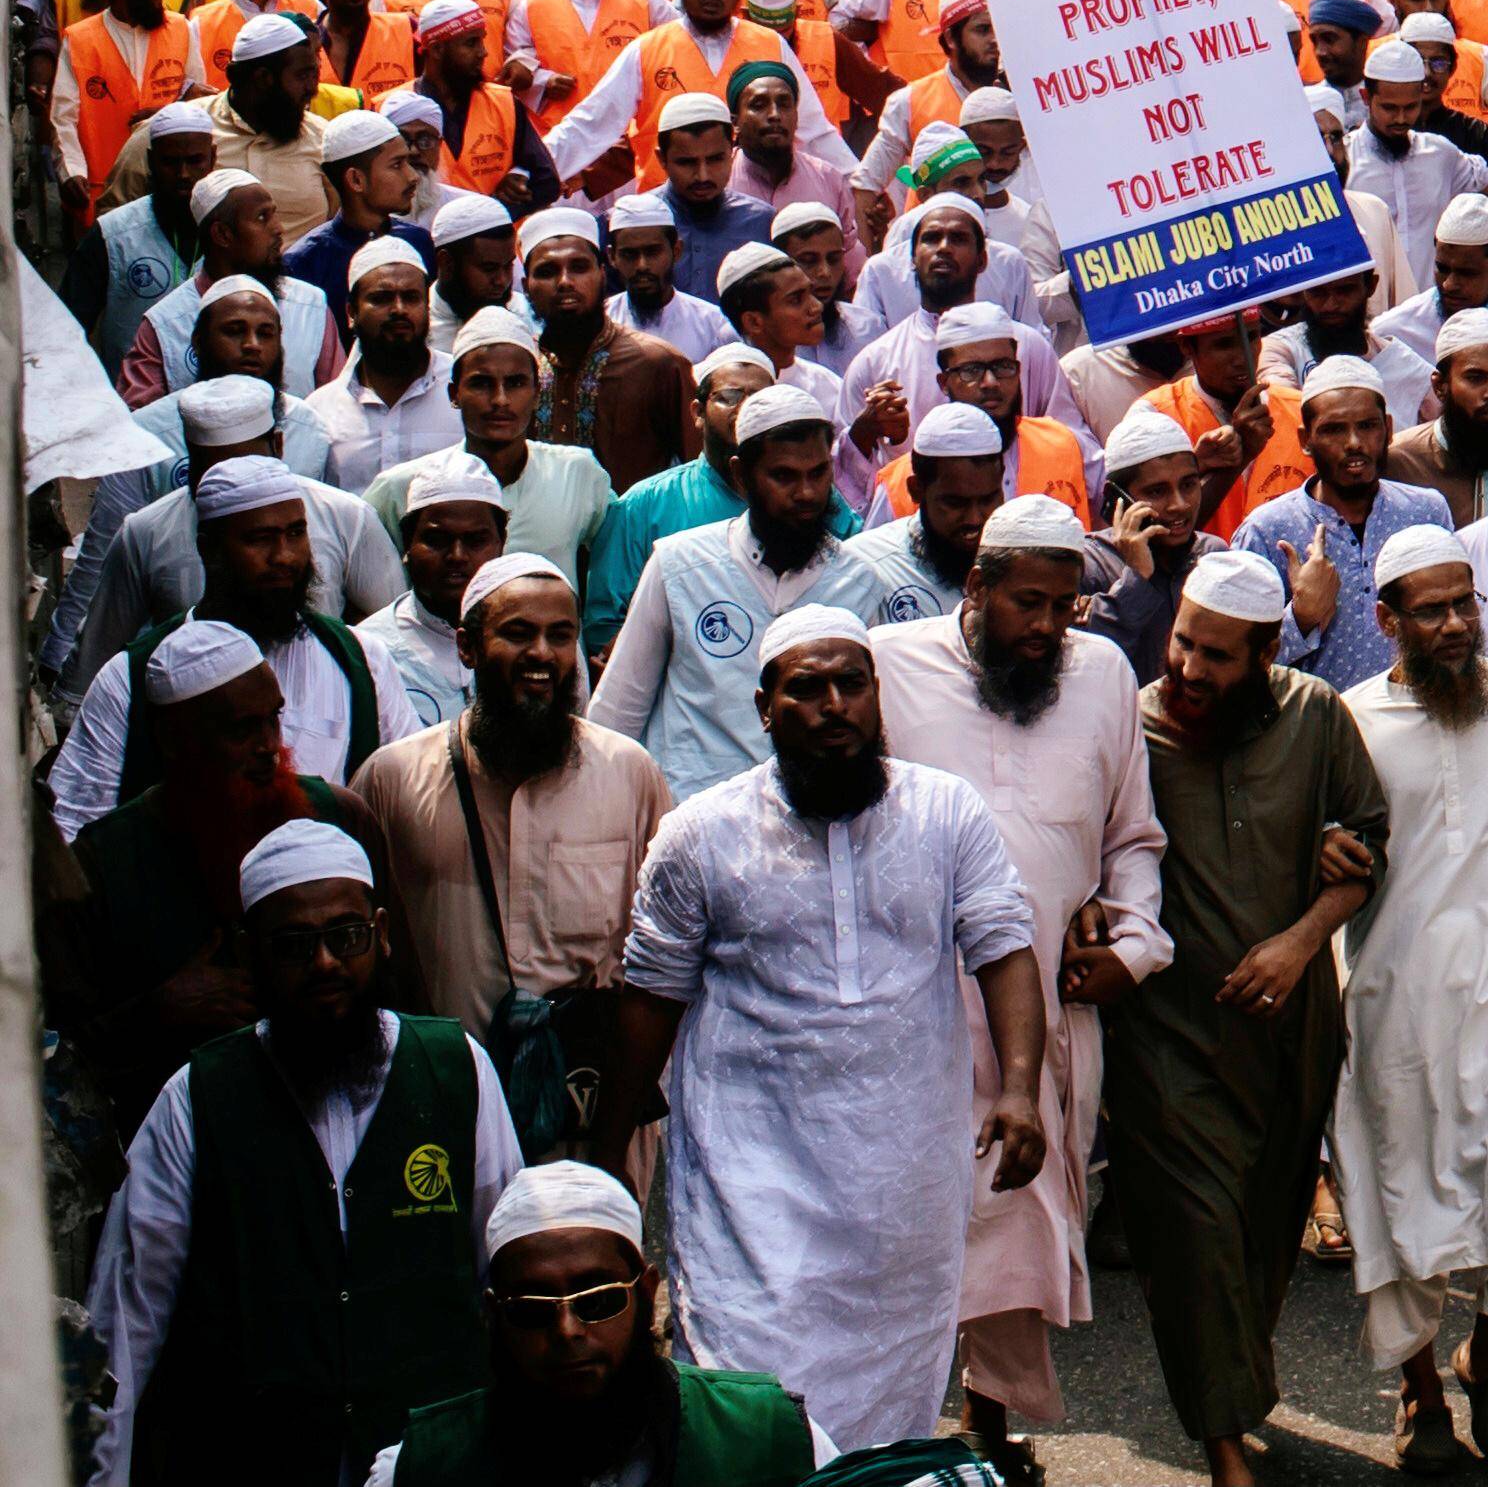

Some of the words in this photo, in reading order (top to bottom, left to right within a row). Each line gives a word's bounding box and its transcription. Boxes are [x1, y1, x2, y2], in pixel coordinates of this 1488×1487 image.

[1032, 47, 1188, 114] MUSLIMS
[1190, 16, 1274, 69] WILL
[1142, 93, 1209, 144] NOT
[1106, 140, 1276, 216] TOLERATE
[1073, 228, 1166, 294] ISLAMI
[1169, 210, 1234, 269] JUBO
[1236, 180, 1342, 246] ANDOLAN
[1134, 274, 1205, 316] Dhaka
[1208, 262, 1251, 299] City
[1252, 240, 1315, 287] North
